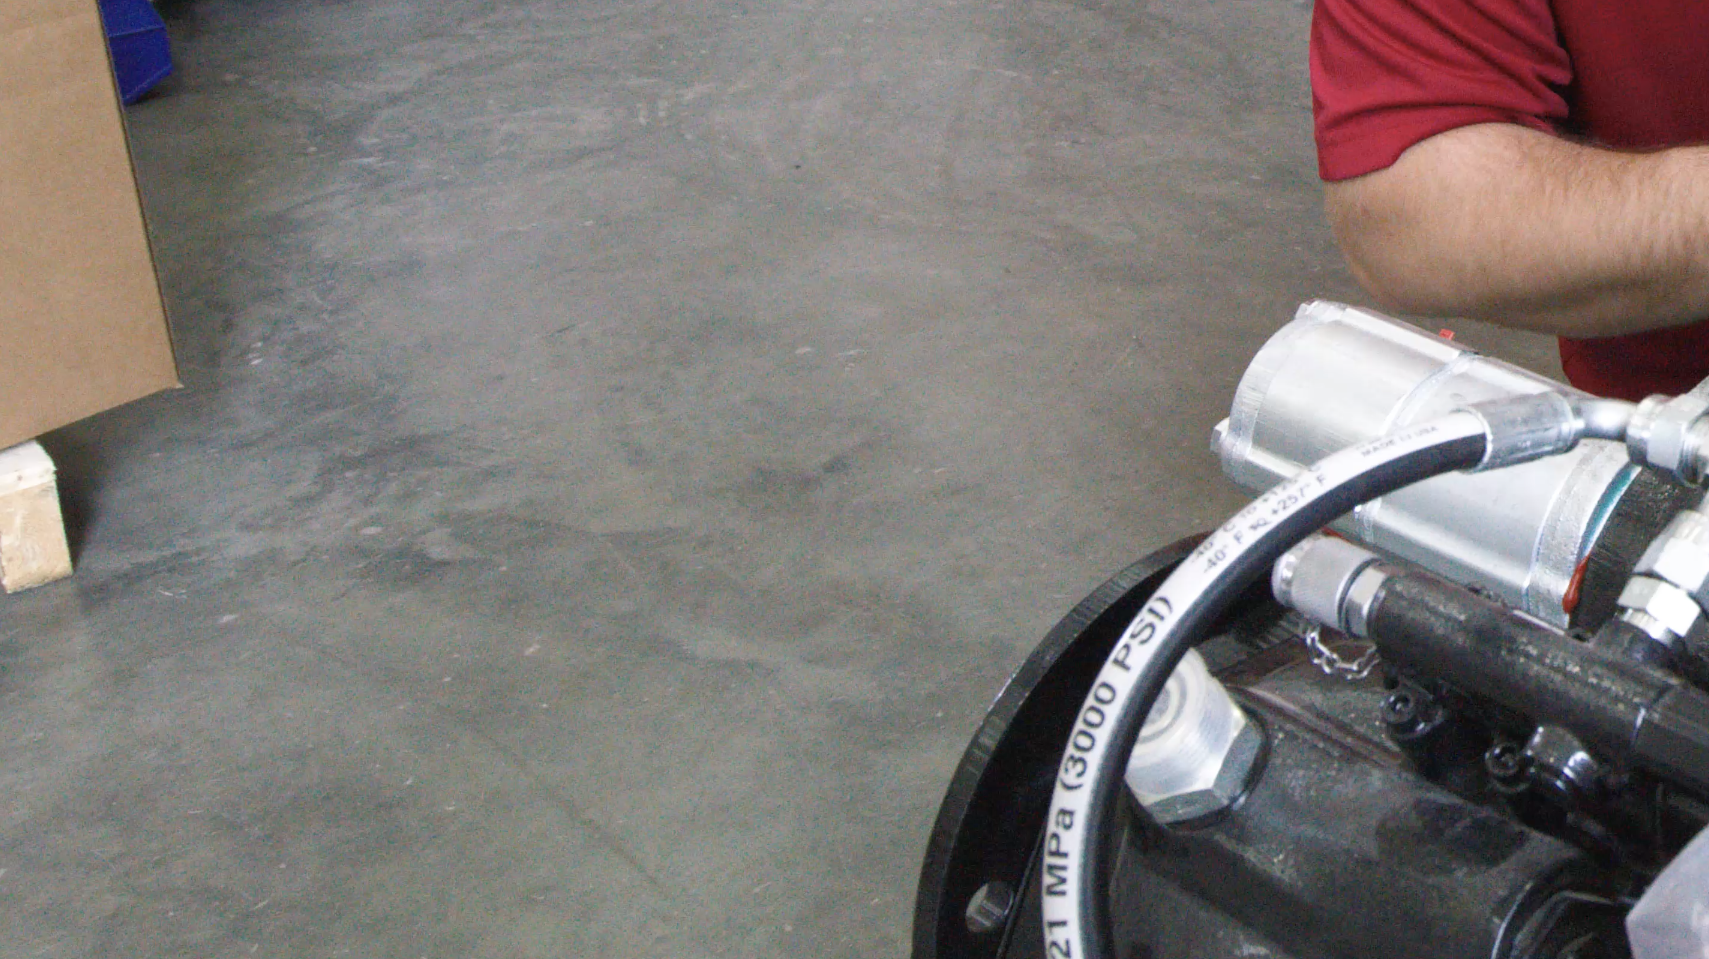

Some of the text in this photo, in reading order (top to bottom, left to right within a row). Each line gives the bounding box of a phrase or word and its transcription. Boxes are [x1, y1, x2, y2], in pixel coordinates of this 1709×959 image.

[1112, 596, 1173, 673] PSI)
[1060, 681, 1117, 791] (3000
[1046, 808, 1075, 897] MPa
